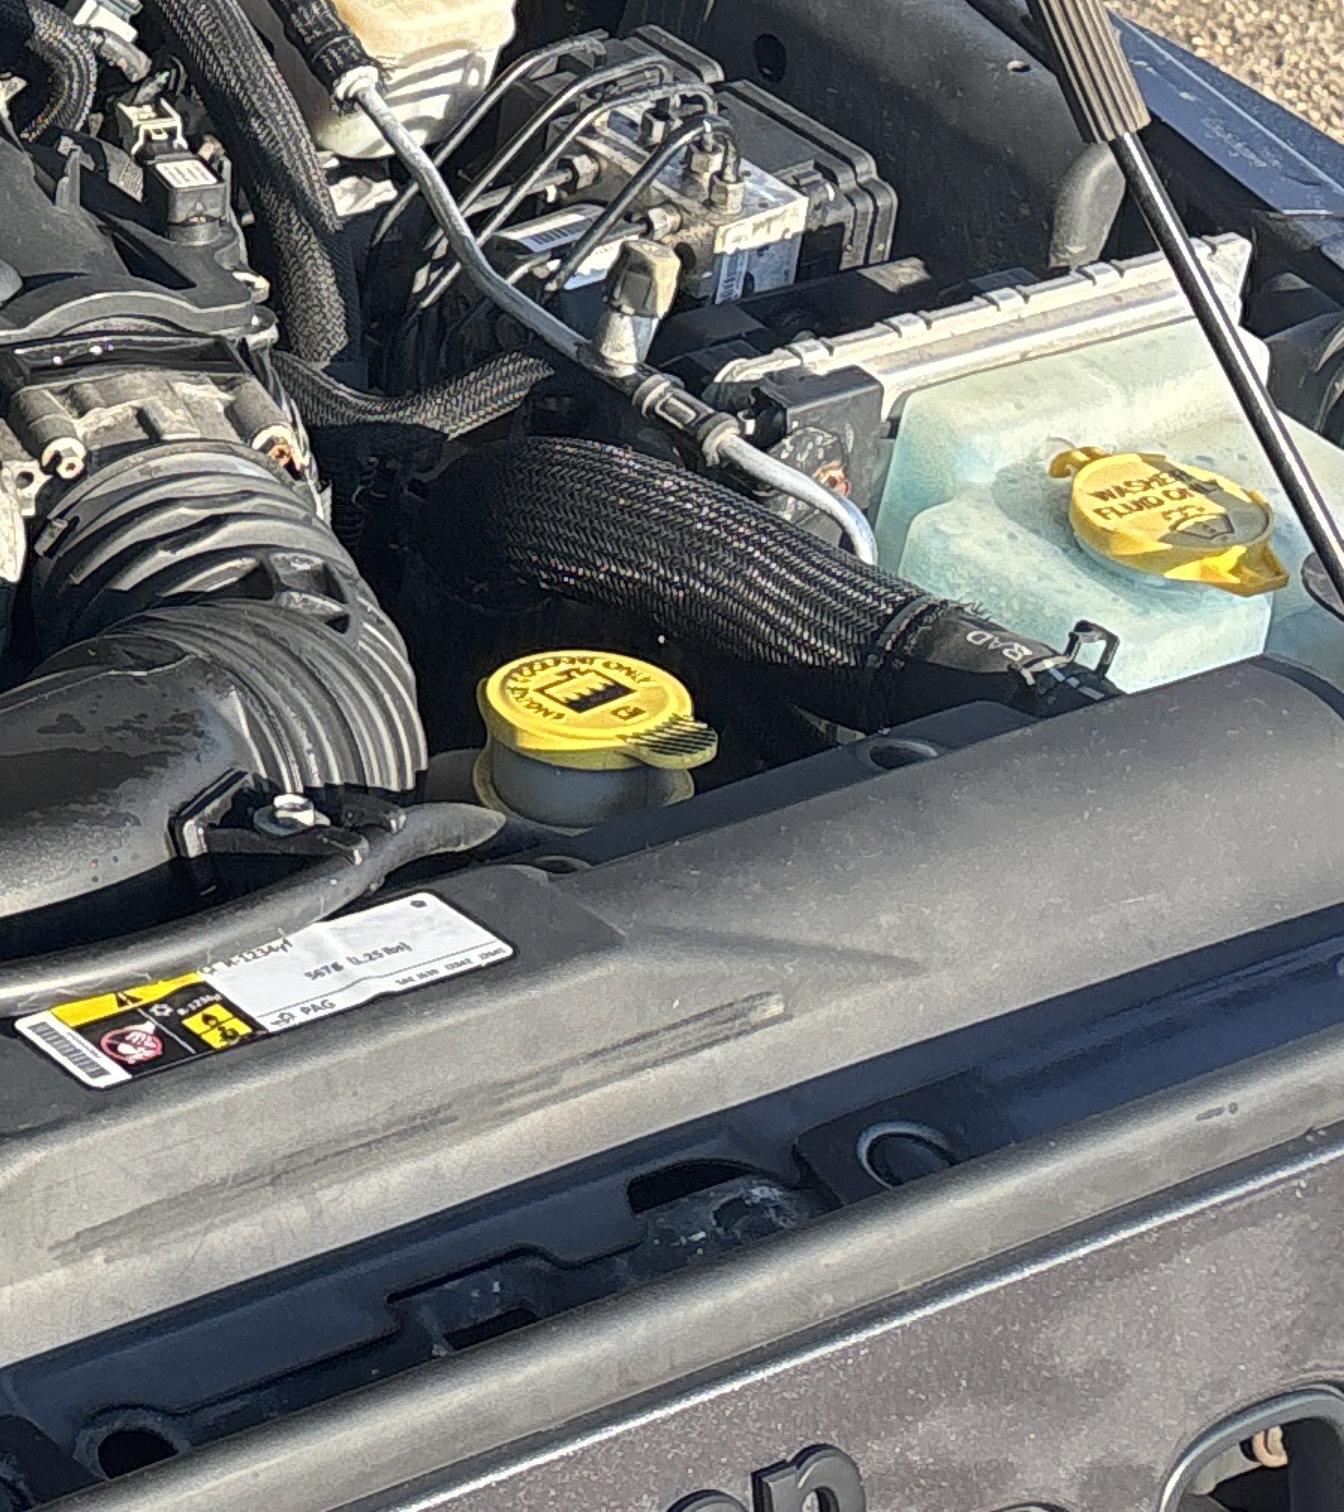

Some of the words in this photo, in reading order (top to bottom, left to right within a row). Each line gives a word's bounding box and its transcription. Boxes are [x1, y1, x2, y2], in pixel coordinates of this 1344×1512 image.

[1093, 492, 1166, 520] FLUID
[966, 630, 1032, 661] RAD
[602, 660, 652, 683] ONLY
[299, 998, 336, 1016] PAG
